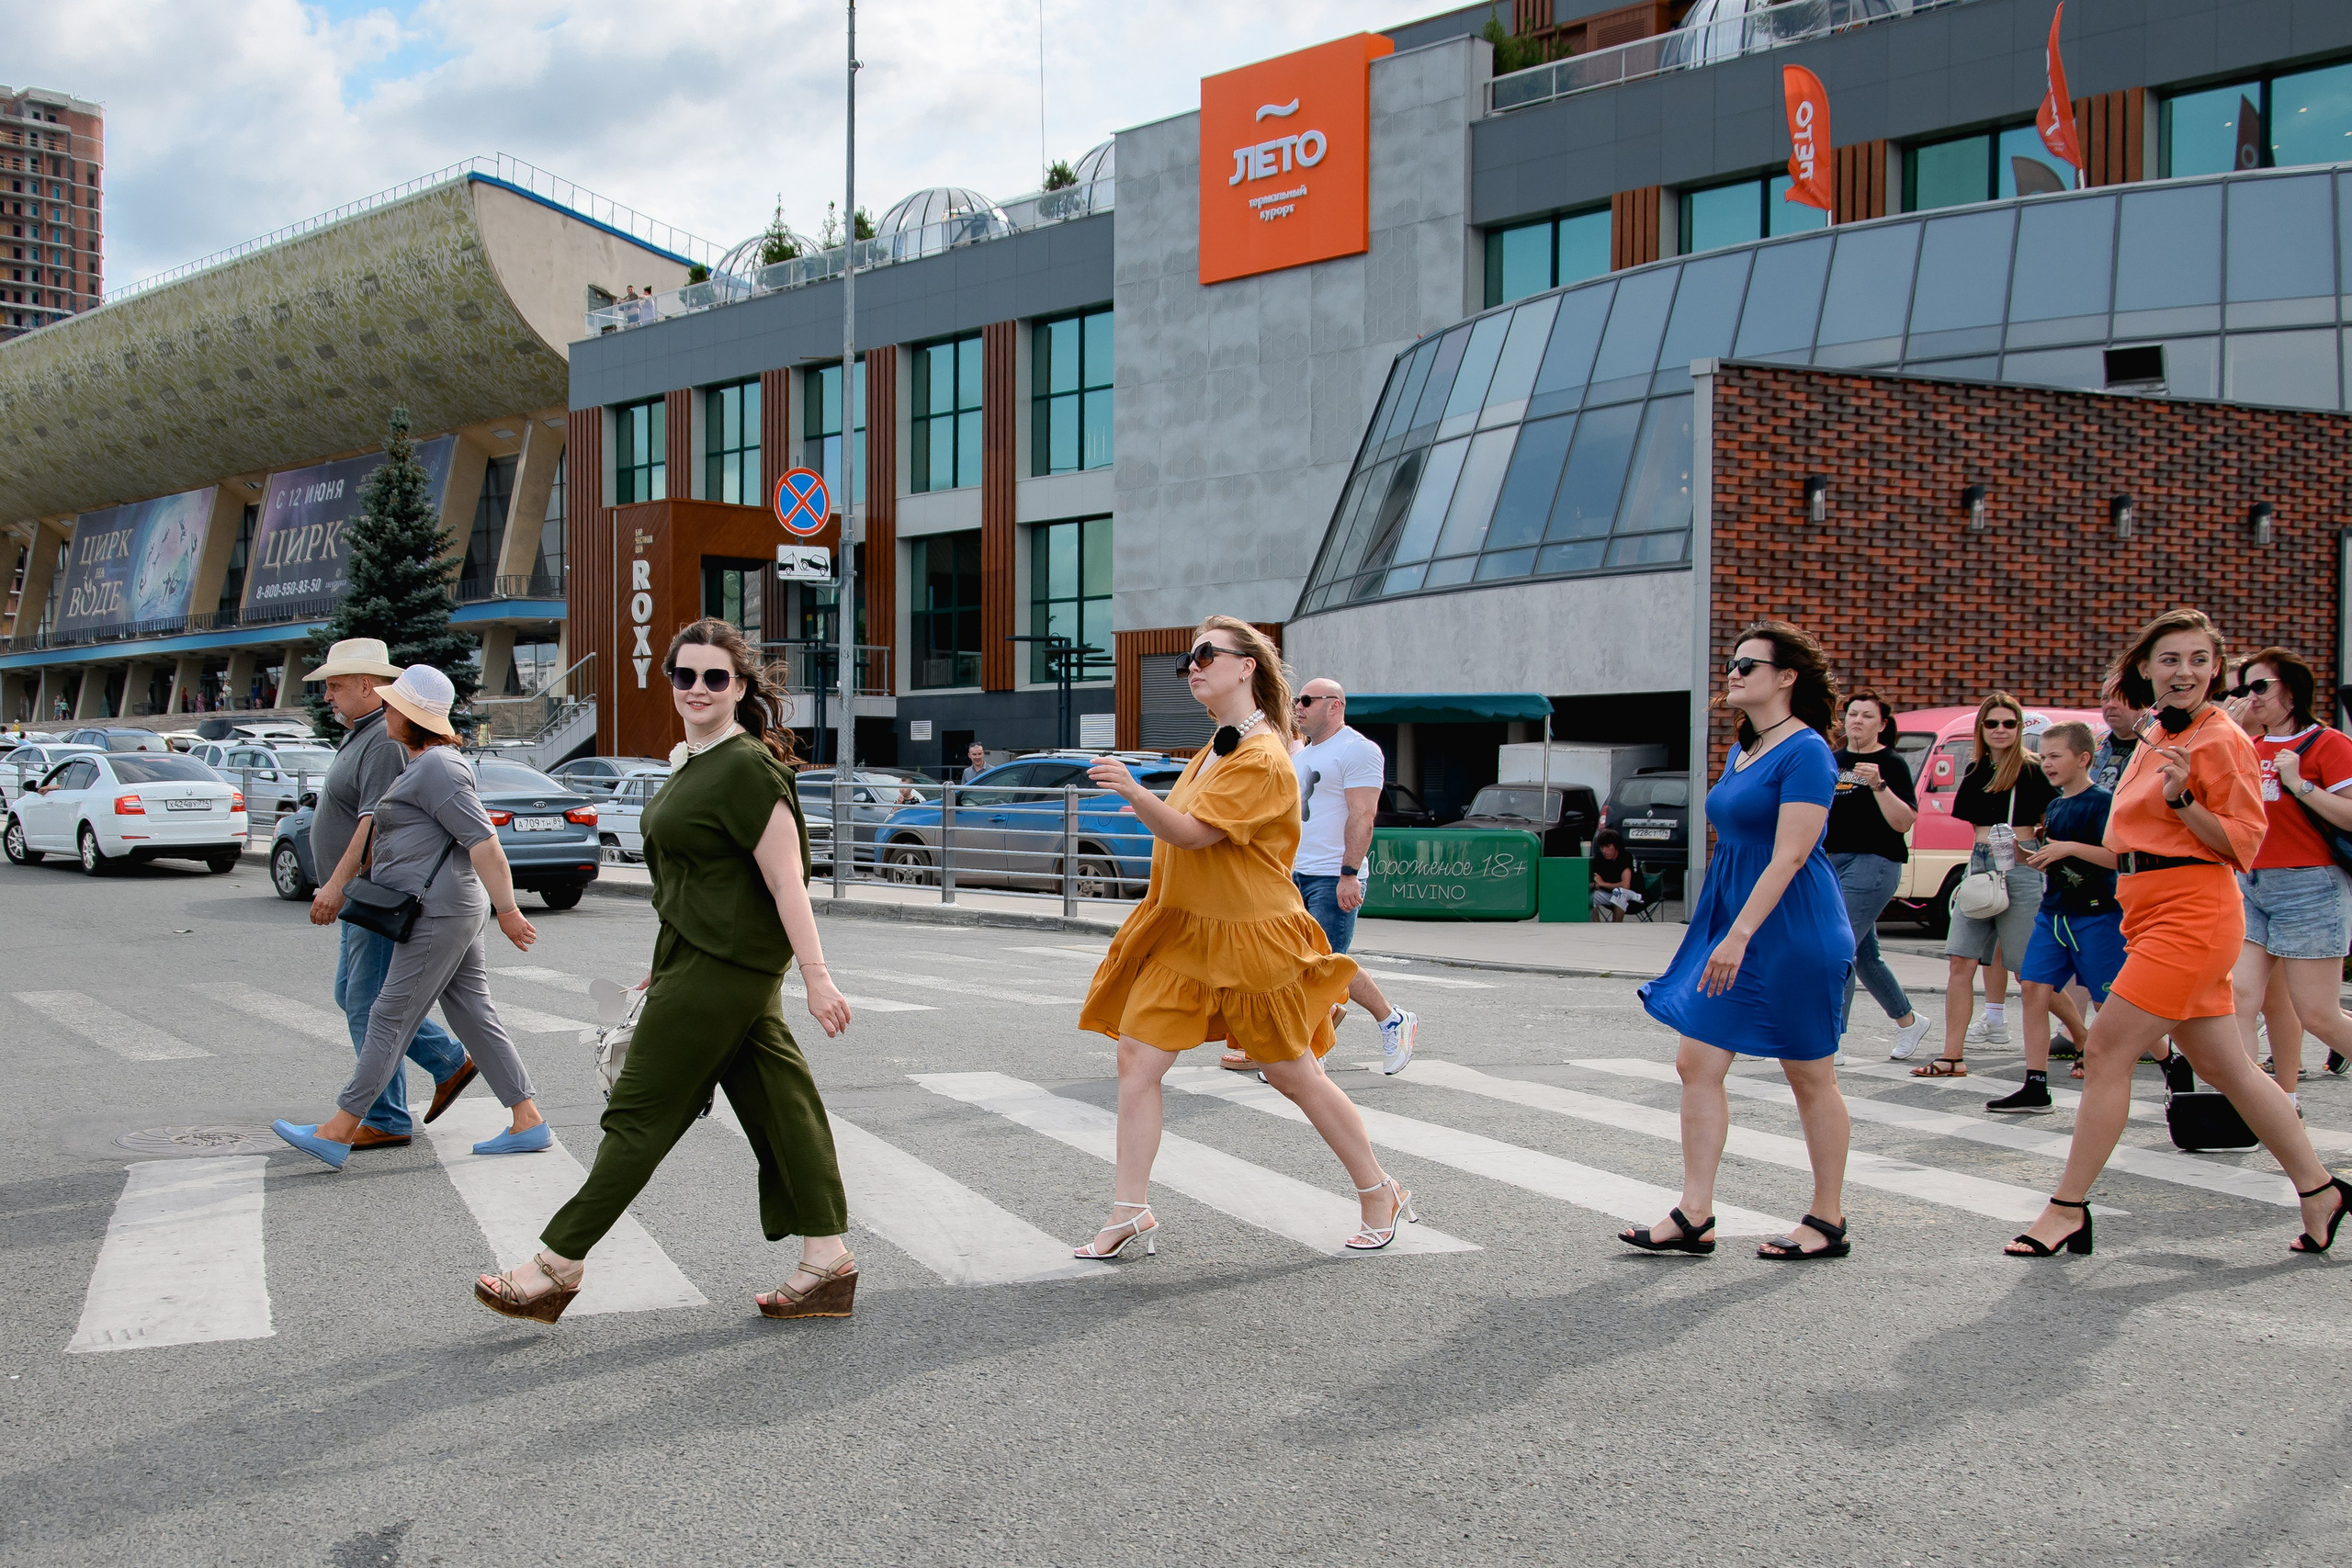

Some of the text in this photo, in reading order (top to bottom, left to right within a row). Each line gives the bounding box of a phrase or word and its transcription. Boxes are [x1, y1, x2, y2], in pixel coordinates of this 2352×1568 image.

[1229, 130, 1328, 186] ЛЕТО
[1248, 185, 1307, 209] термальный
[1259, 203, 1295, 222] курорт
[276, 490, 285, 509] С
[288, 487, 302, 507] 12
[304, 479, 345, 504] ИЮНЯ
[79, 528, 135, 567] ЦИРК
[262, 520, 344, 576] ЦИРК
[95, 566, 106, 579] НА
[66, 580, 123, 620] ВОДЕ
[256, 578, 322, 600] 8-800-550-93-50
[631, 559, 653, 689] ROXY
[1482, 852, 1526, 878] 18+
[1392, 884, 1466, 900] MIVINO
